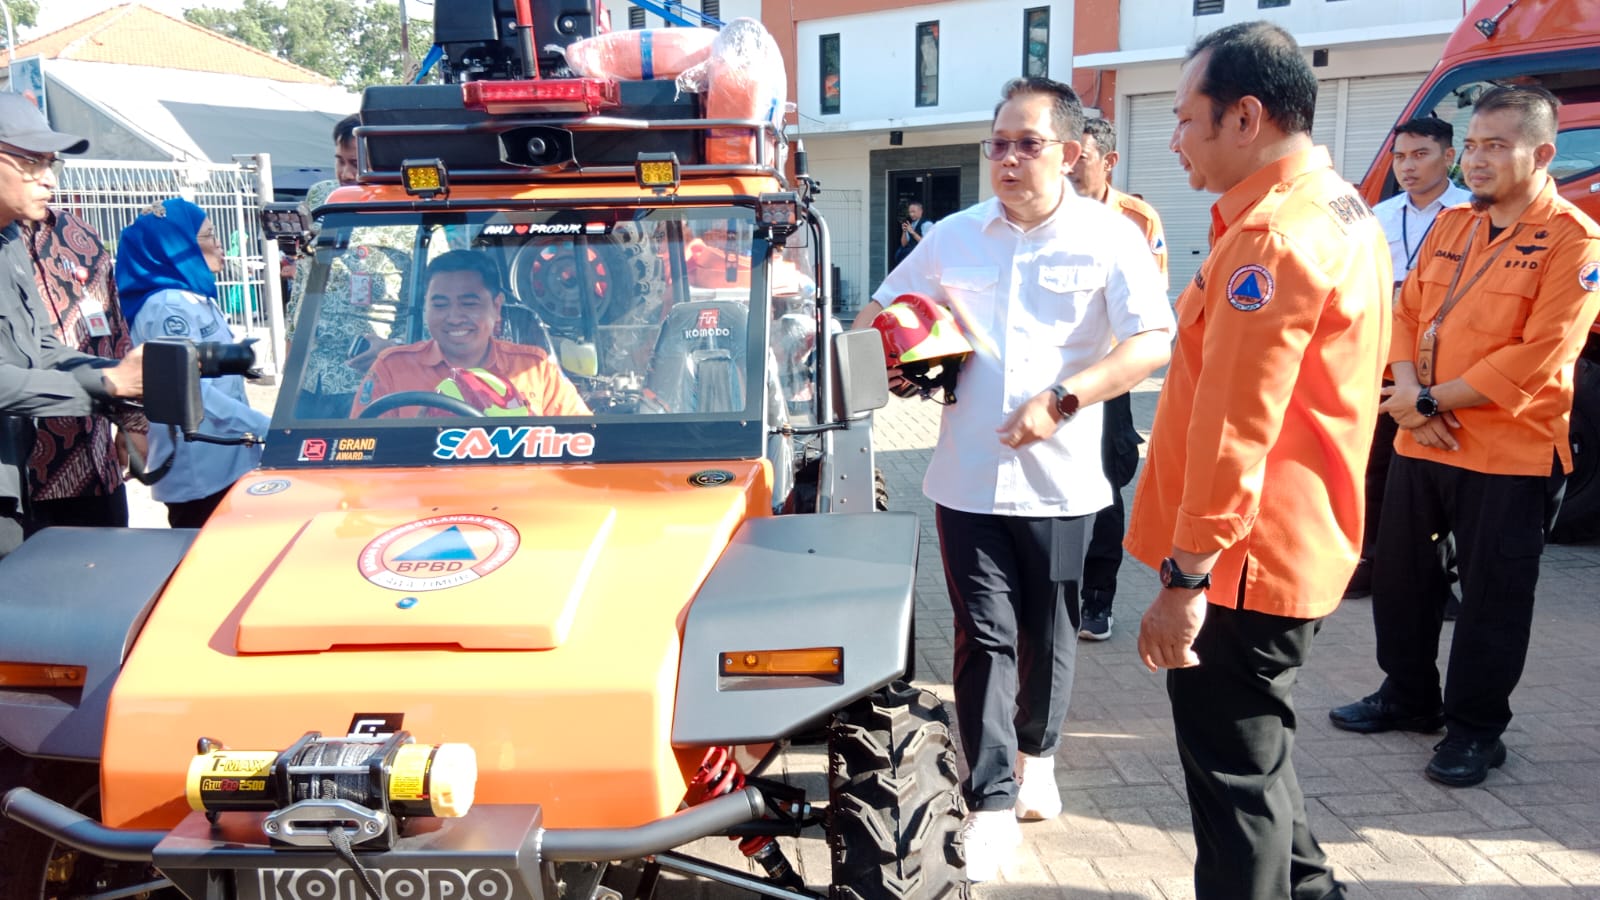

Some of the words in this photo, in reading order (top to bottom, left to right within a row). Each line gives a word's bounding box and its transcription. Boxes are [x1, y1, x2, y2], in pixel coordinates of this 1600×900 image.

[483, 225, 514, 235] AKU
[528, 224, 582, 234] PRODUK
[1504, 260, 1538, 270] BPBD
[684, 328, 730, 339] KOMODO
[339, 438, 375, 450] GRAND
[335, 452, 364, 461] AWARD
[396, 561, 463, 573] BPBD
[239, 780, 265, 791] 2500
[258, 868, 513, 900] KOMODO
